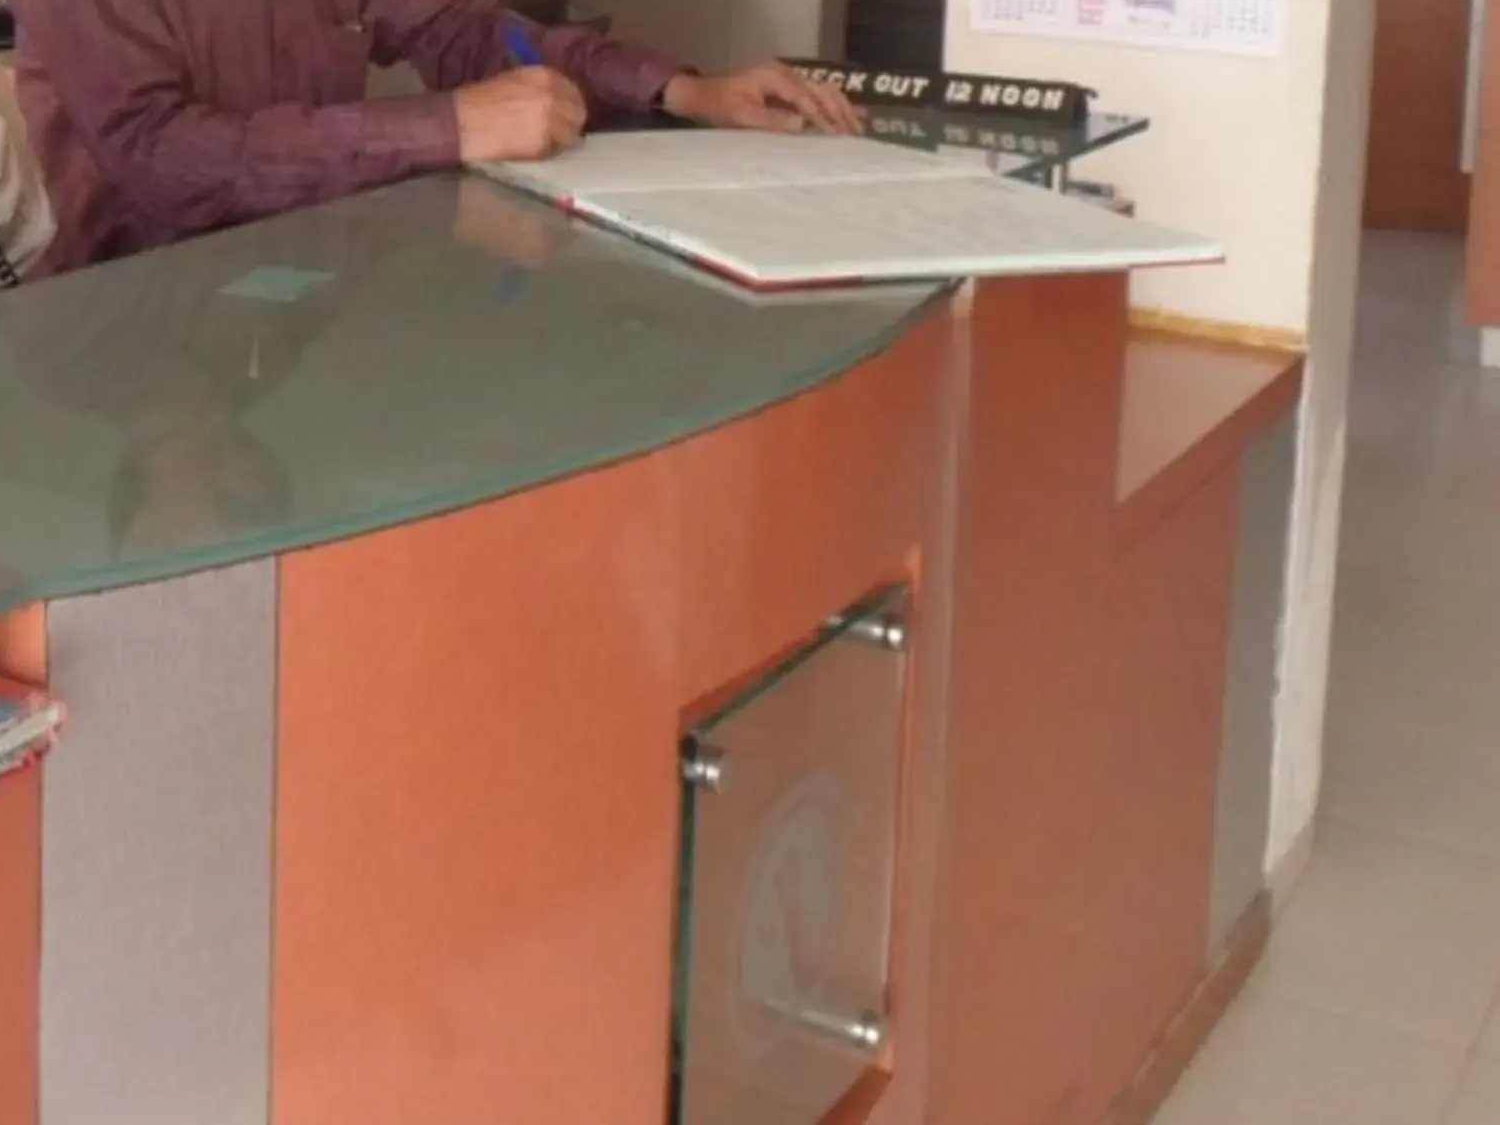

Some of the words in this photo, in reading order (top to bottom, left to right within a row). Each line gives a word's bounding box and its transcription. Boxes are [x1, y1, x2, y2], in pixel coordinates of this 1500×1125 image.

[871, 70, 931, 99] OUT
[943, 78, 974, 105] 12
[978, 82, 1065, 112] NOON
